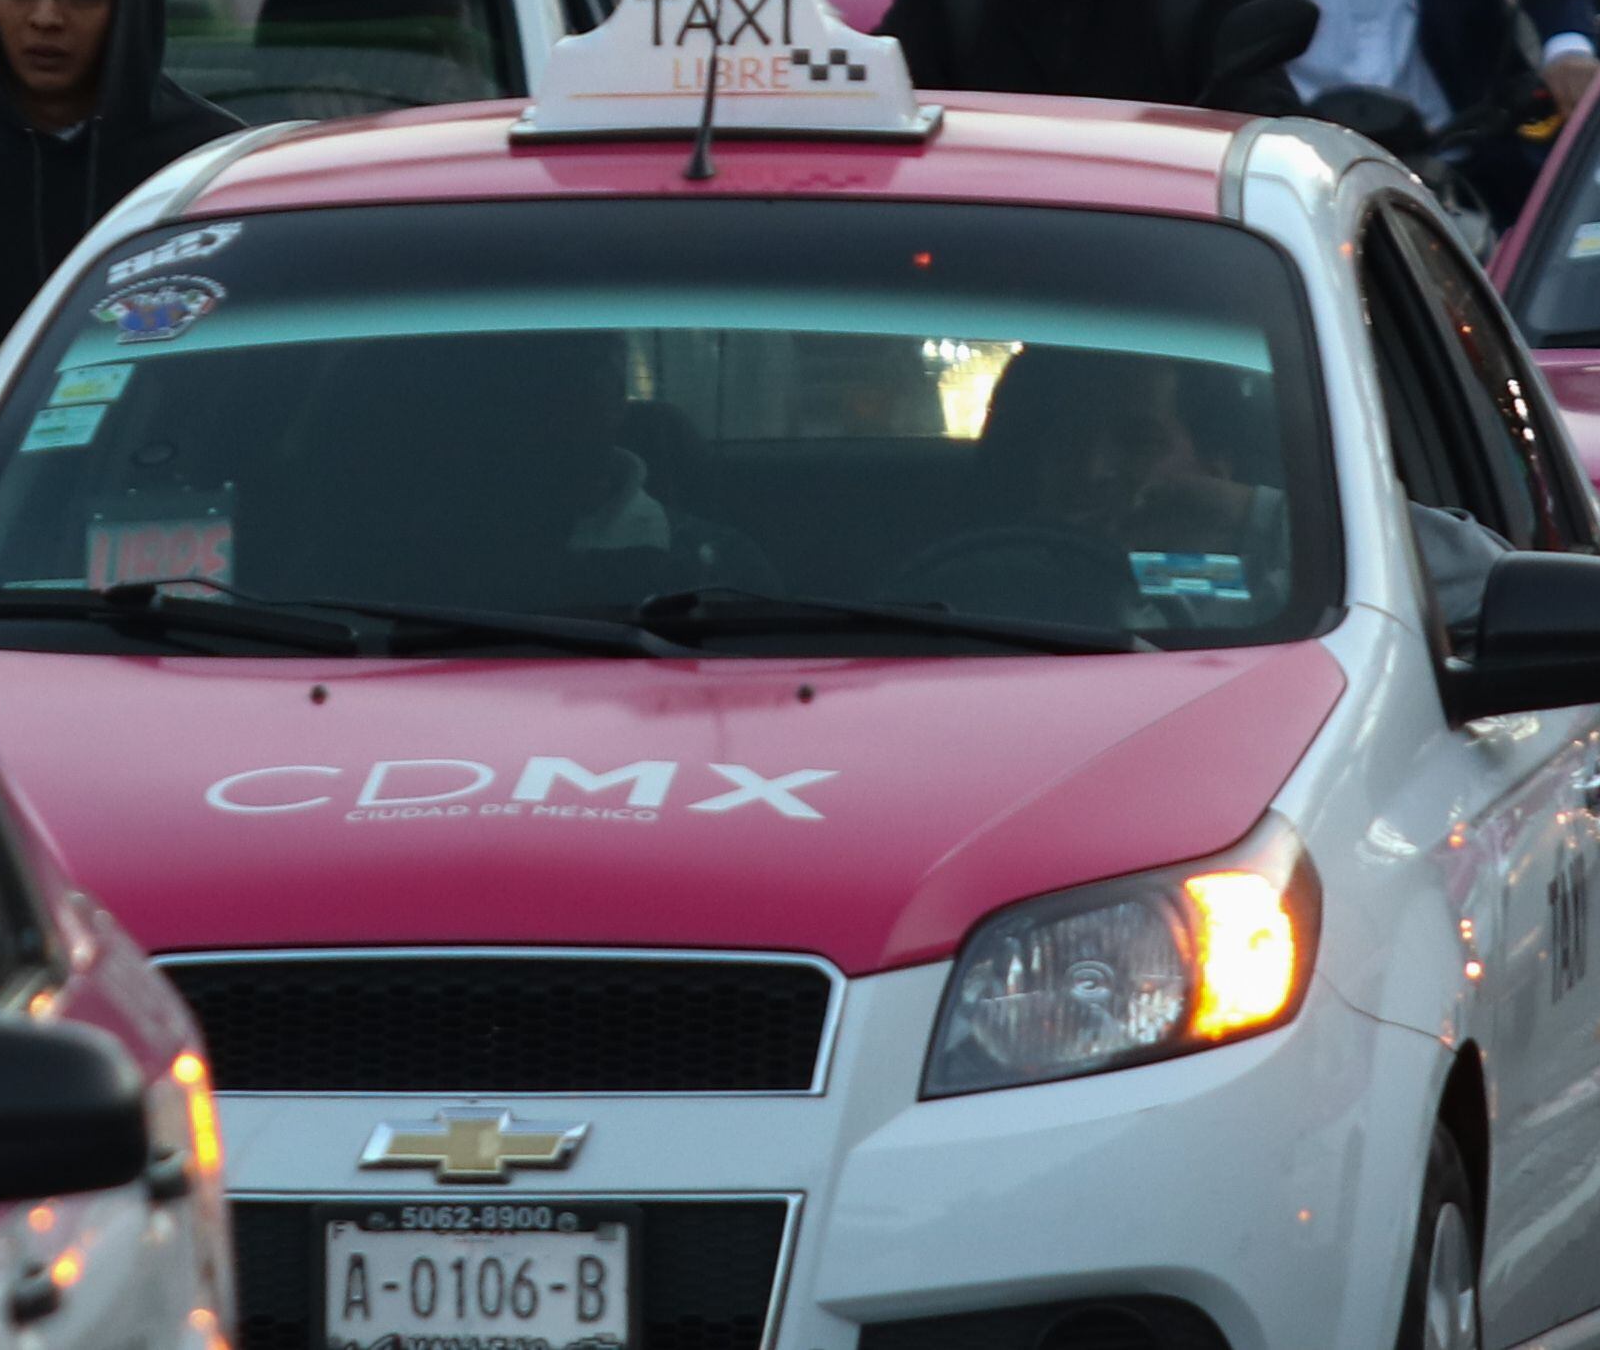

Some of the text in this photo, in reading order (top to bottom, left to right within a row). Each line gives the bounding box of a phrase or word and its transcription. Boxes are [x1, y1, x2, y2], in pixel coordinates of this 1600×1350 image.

[673, 55, 791, 90] LIBRE
[204, 756, 841, 819] CDMX
[345, 804, 470, 823] CIUDAD
[479, 802, 523, 816] DE
[400, 1205, 552, 1229] 5062-8900
[343, 1253, 607, 1322] A-0106-B
